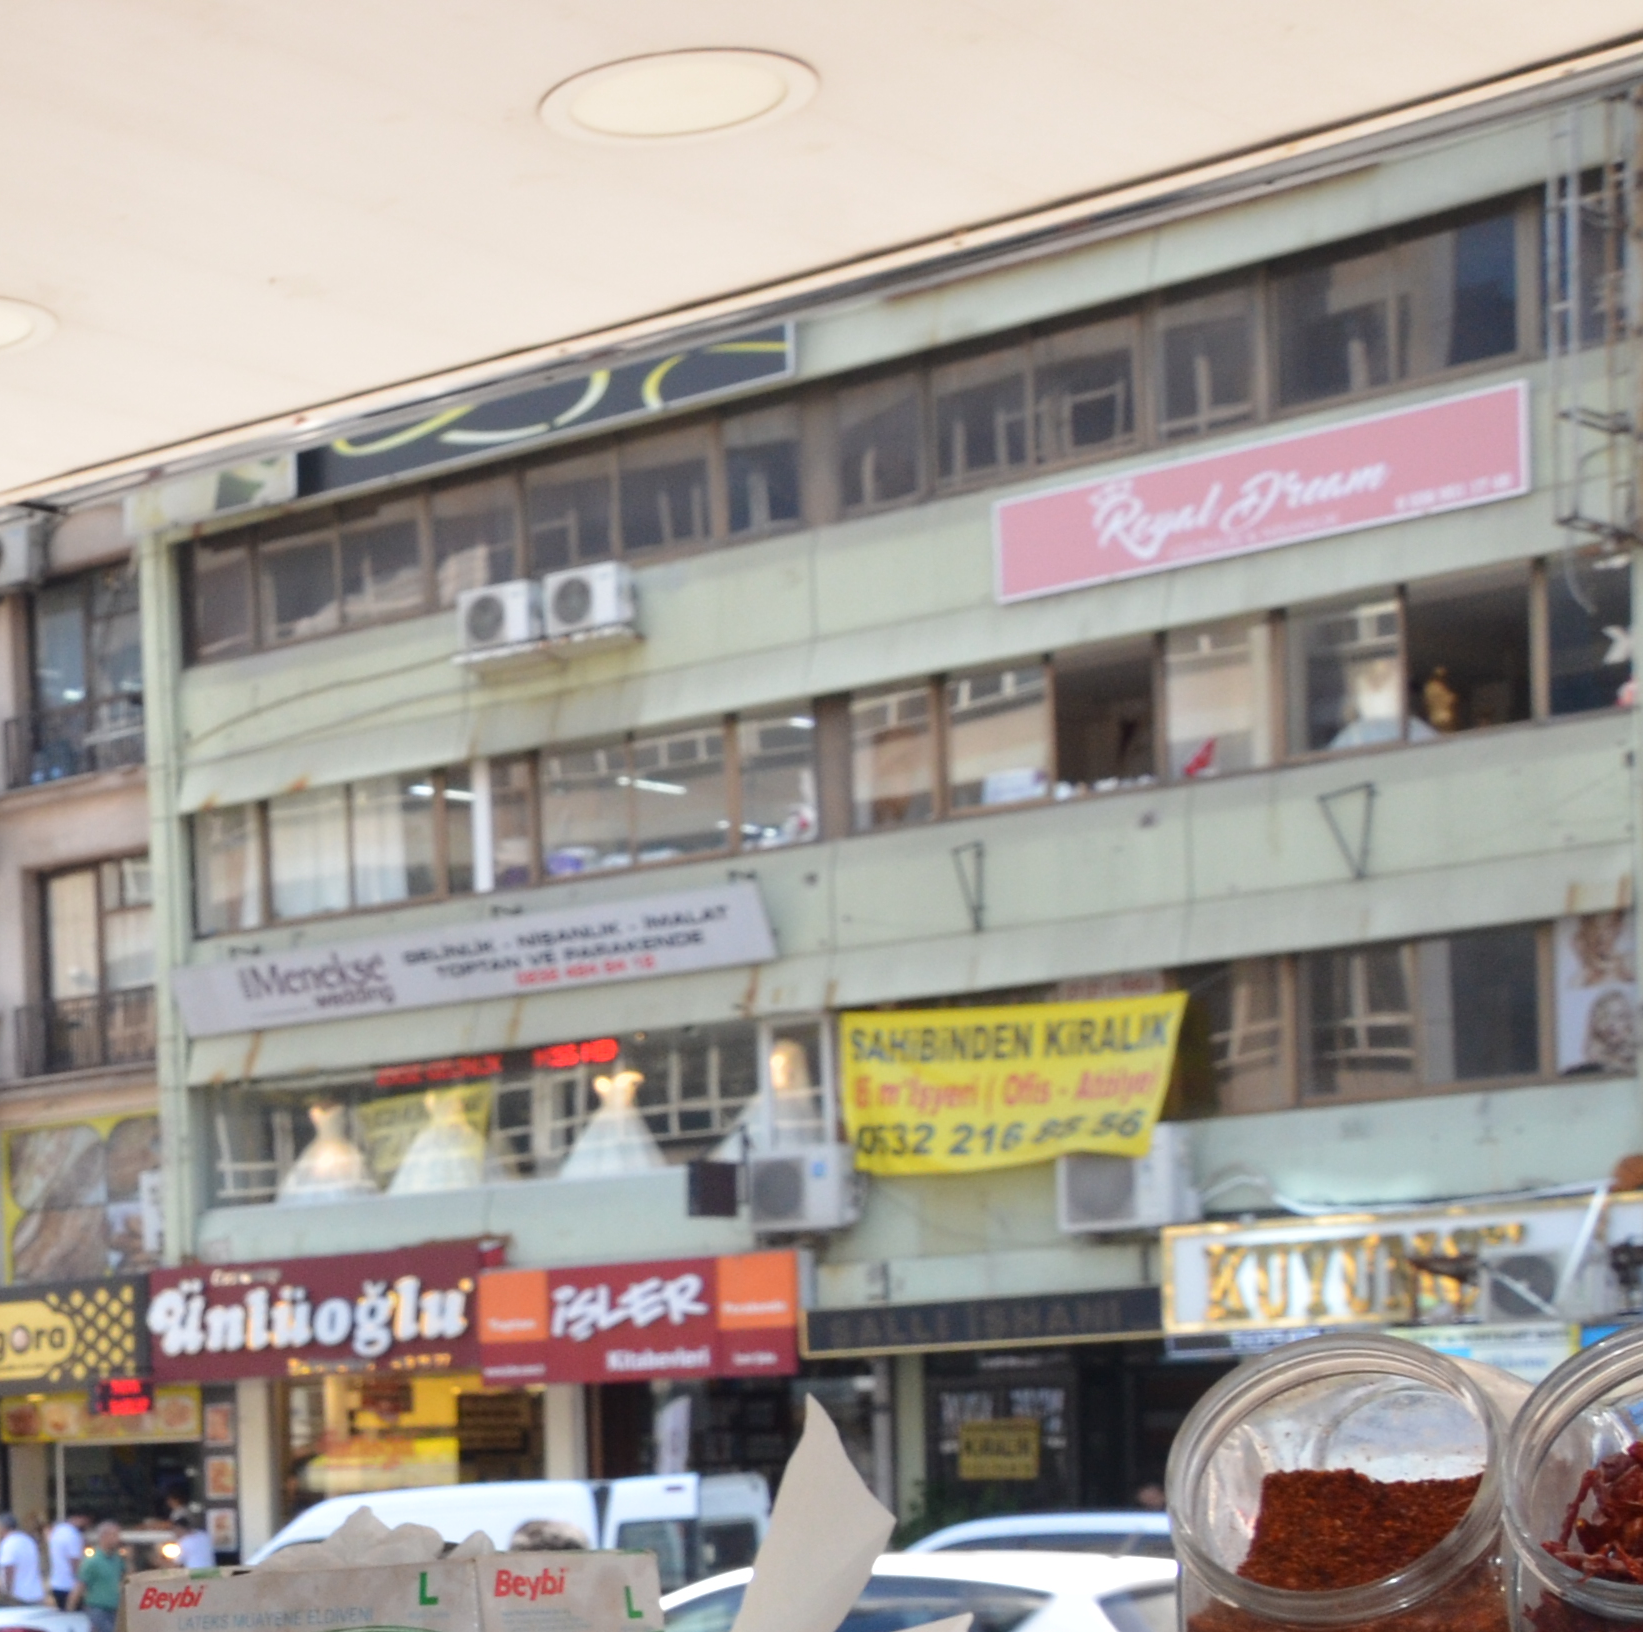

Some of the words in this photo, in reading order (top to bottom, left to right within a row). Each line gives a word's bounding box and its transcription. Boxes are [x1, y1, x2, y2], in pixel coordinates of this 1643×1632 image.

[1093, 483, 1221, 560] Royal
[1219, 462, 1389, 533] Dream
[530, 949, 556, 968] VE
[146, 1275, 467, 1357] Ünlüoğlu
[138, 1584, 206, 1612] Beybi
[418, 1571, 439, 1605] L
[494, 1567, 567, 1601] Beybi
[623, 1585, 643, 1619] L
[177, 1610, 230, 1632] LATEKS
[232, 1610, 303, 1630] MUAYENE
